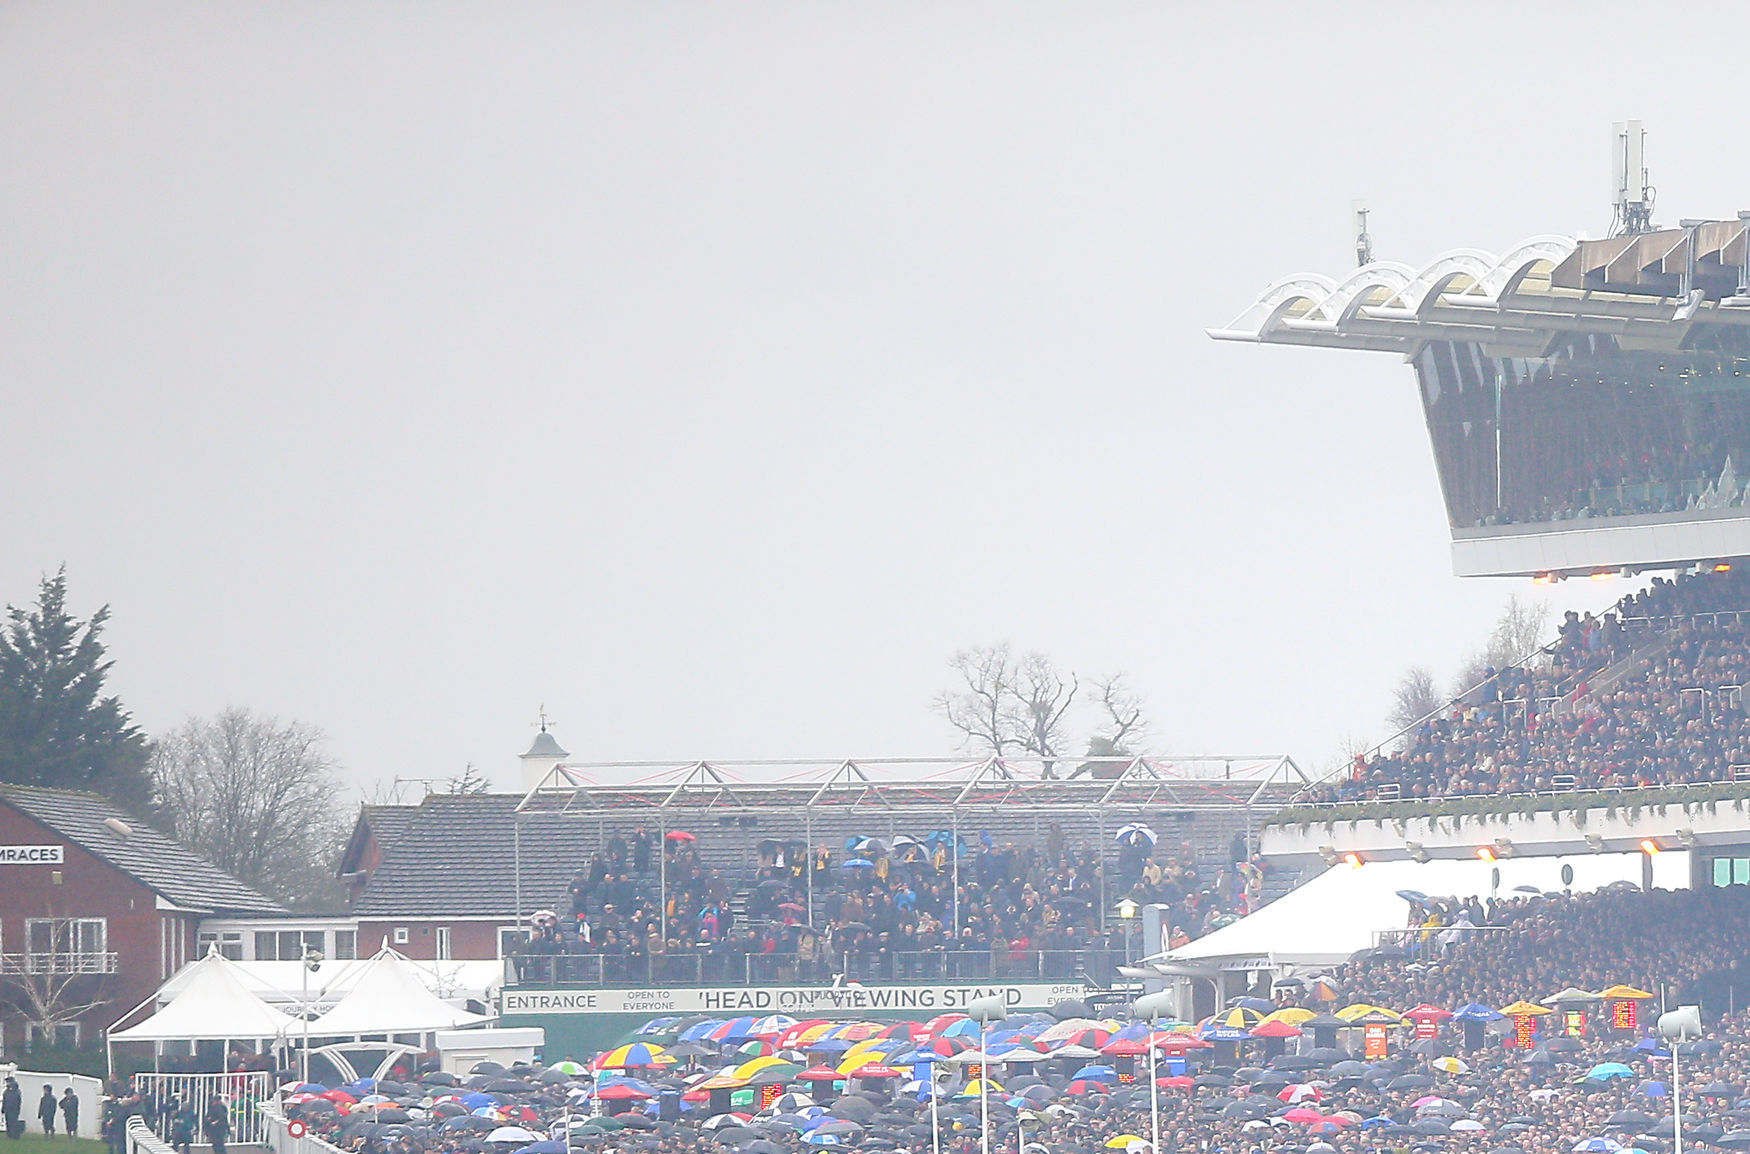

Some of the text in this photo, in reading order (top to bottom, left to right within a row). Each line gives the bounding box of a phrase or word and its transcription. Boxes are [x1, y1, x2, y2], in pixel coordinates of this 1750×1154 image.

[1052, 985, 1079, 995] OPEN
[627, 991, 670, 1000] OPEN TO
[699, 990, 770, 1009] 'HEAD
[780, 991, 815, 1006] ON
[833, 990, 935, 1007] VIEWING
[507, 994, 597, 1008] ENTRANCE
[622, 1001, 675, 1010] EVERYONE
